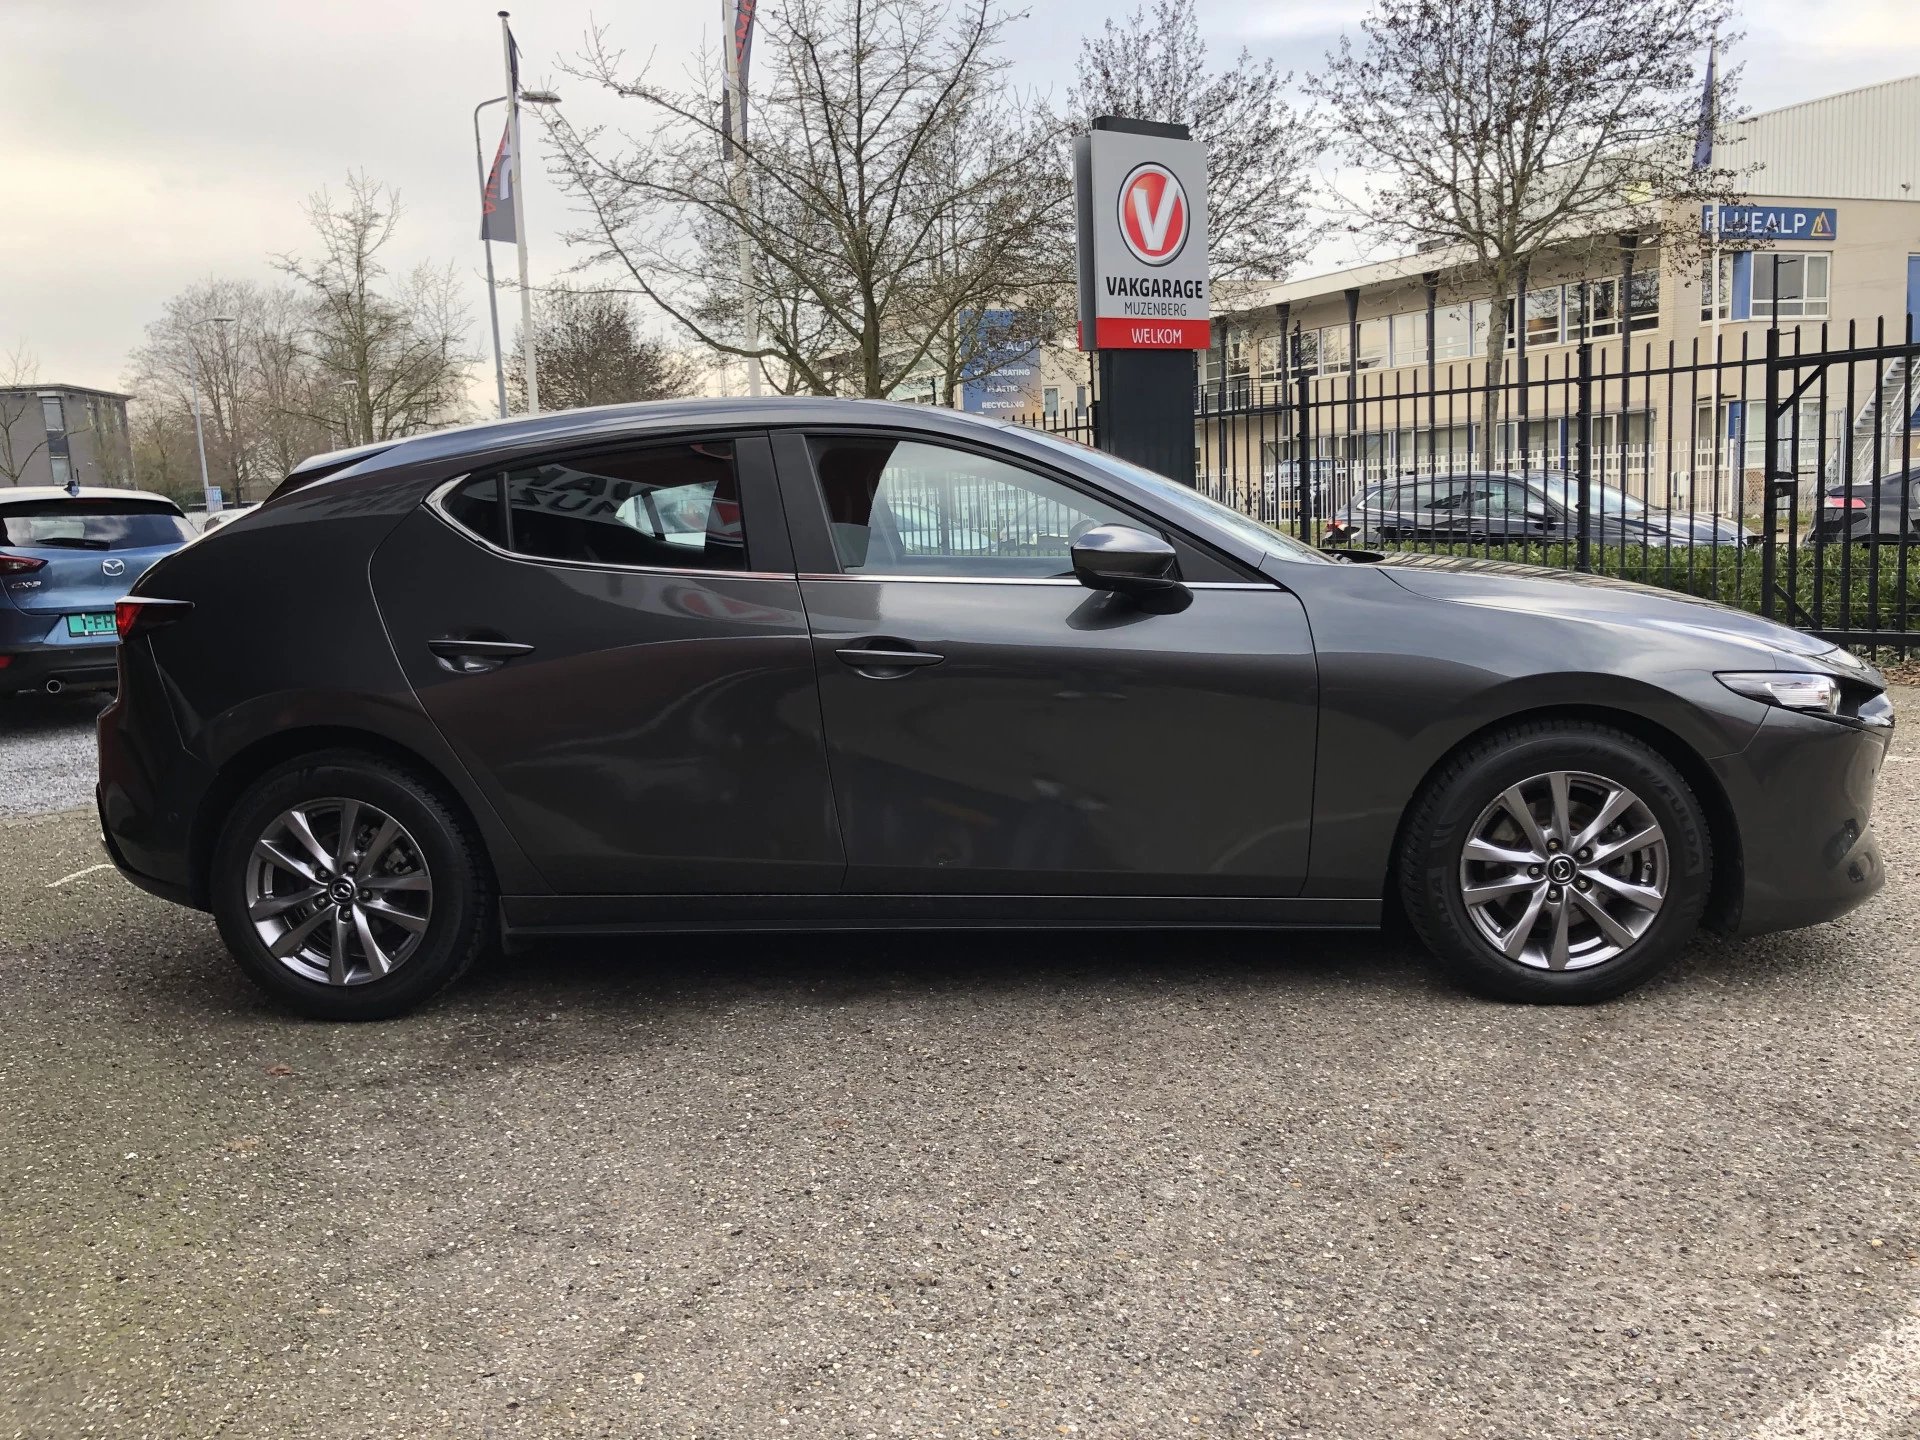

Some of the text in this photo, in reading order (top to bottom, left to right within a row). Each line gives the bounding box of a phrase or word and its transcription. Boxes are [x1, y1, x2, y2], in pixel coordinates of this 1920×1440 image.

[1133, 174, 1180, 251] V
[1105, 276, 1203, 299] VAKGARAGE
[1124, 301, 1187, 317] MUZENBERG
[1131, 327, 1182, 345] WELKOM
